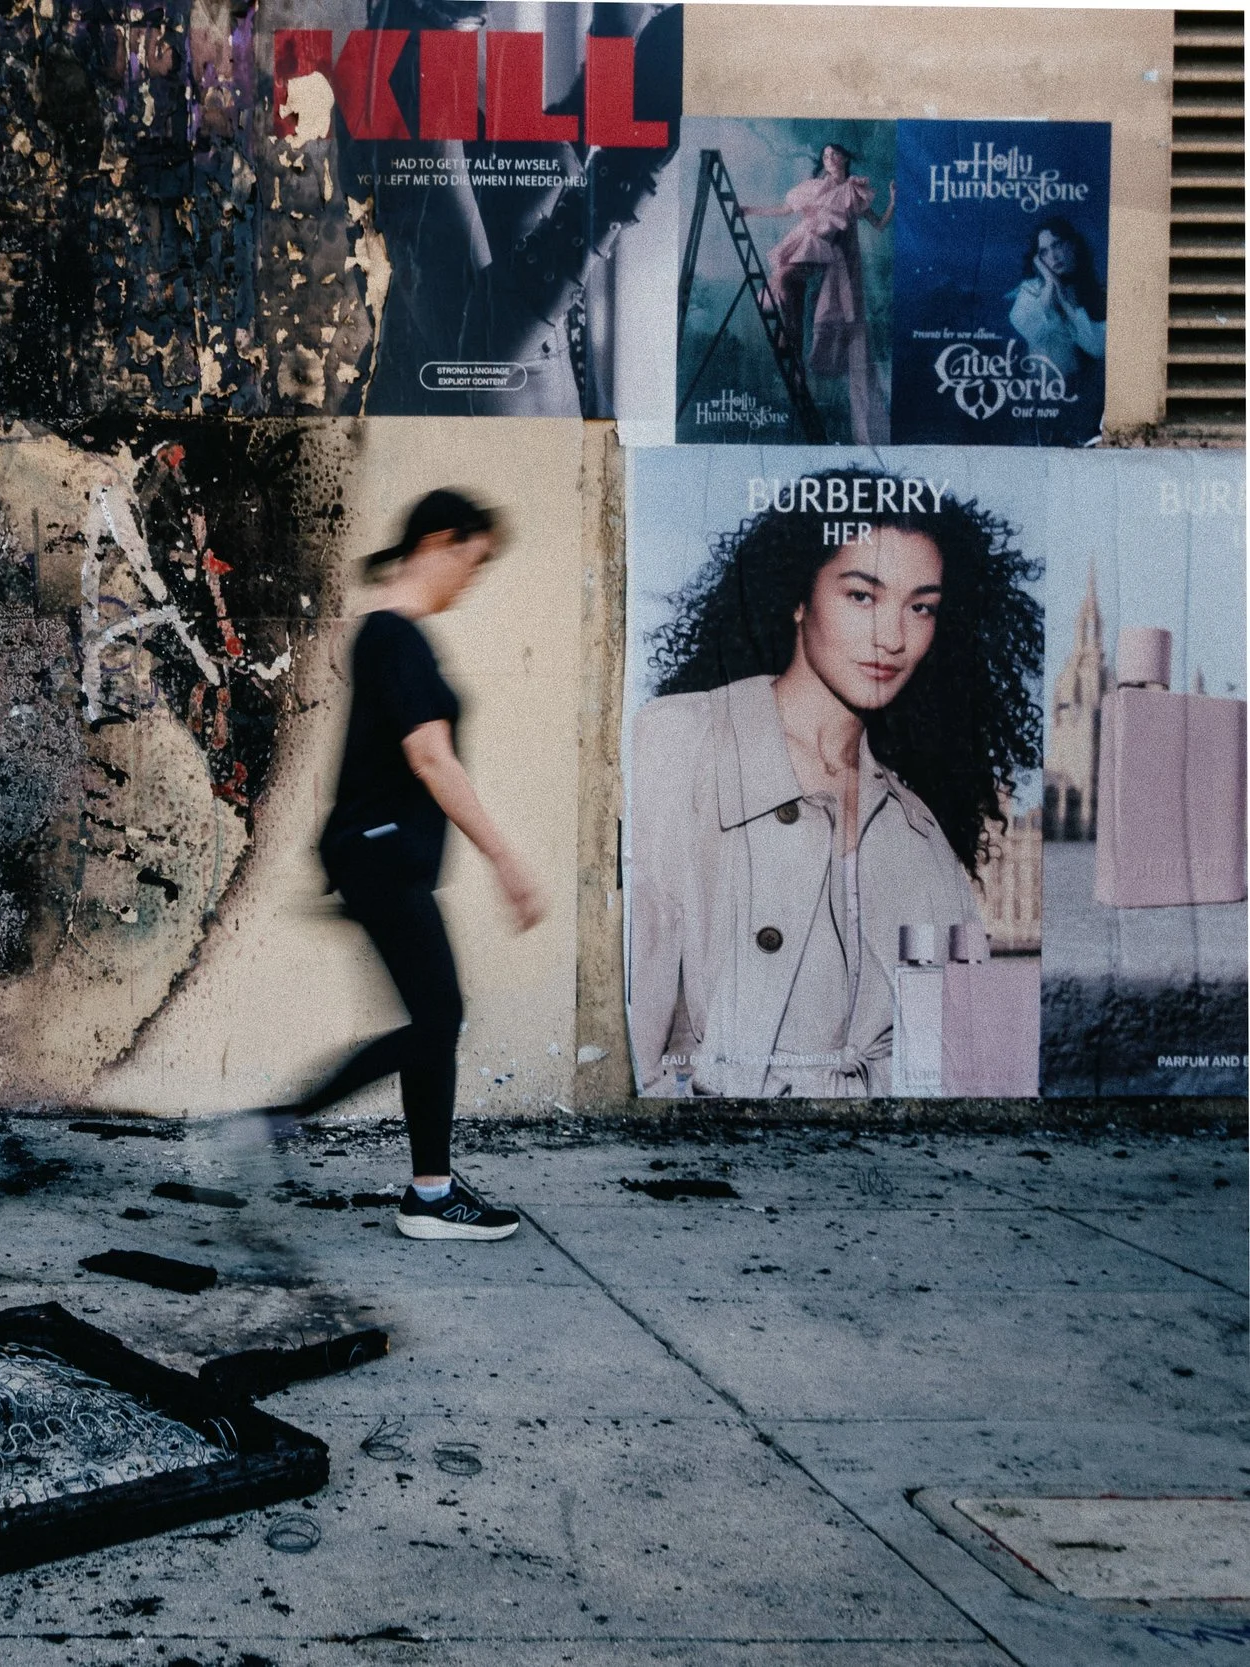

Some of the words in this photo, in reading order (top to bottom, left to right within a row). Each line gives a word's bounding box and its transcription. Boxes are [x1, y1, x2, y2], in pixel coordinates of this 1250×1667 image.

[273, 29, 669, 148] KILL
[391, 158, 417, 169] HAD
[418, 158, 434, 169] TO
[436, 158, 458, 170] GET
[462, 159, 471, 170] IT
[474, 159, 495, 170] ALL
[497, 159, 512, 170] BY
[514, 159, 560, 172] MYSELF,
[954, 142, 1033, 181] Holly
[384, 174, 410, 186] LEFT
[413, 175, 430, 186] ME
[432, 175, 448, 186] TO
[450, 175, 470, 187] DIE
[471, 175, 507, 187] WHEN
[515, 176, 562, 187] NEEDED
[929, 165, 1089, 213] Humberstone
[436, 366, 468, 375] STRONG
[469, 366, 510, 375] LANGUAGE
[934, 339, 1018, 394] Cruel
[438, 378, 471, 386] EXPLICIT
[472, 378, 508, 386] CONTENT
[949, 353, 1079, 420] World
[710, 389, 757, 412] Holly
[1011, 406, 1035, 418] Out
[1037, 407, 1060, 418] now
[695, 402, 791, 430] Humberstone
[749, 477, 950, 514] BURBERRY
[822, 521, 874, 546] HER
[661, 1054, 687, 1066] EAU
[1157, 1055, 1209, 1067] PARFUM
[1211, 1055, 1240, 1067] AND
